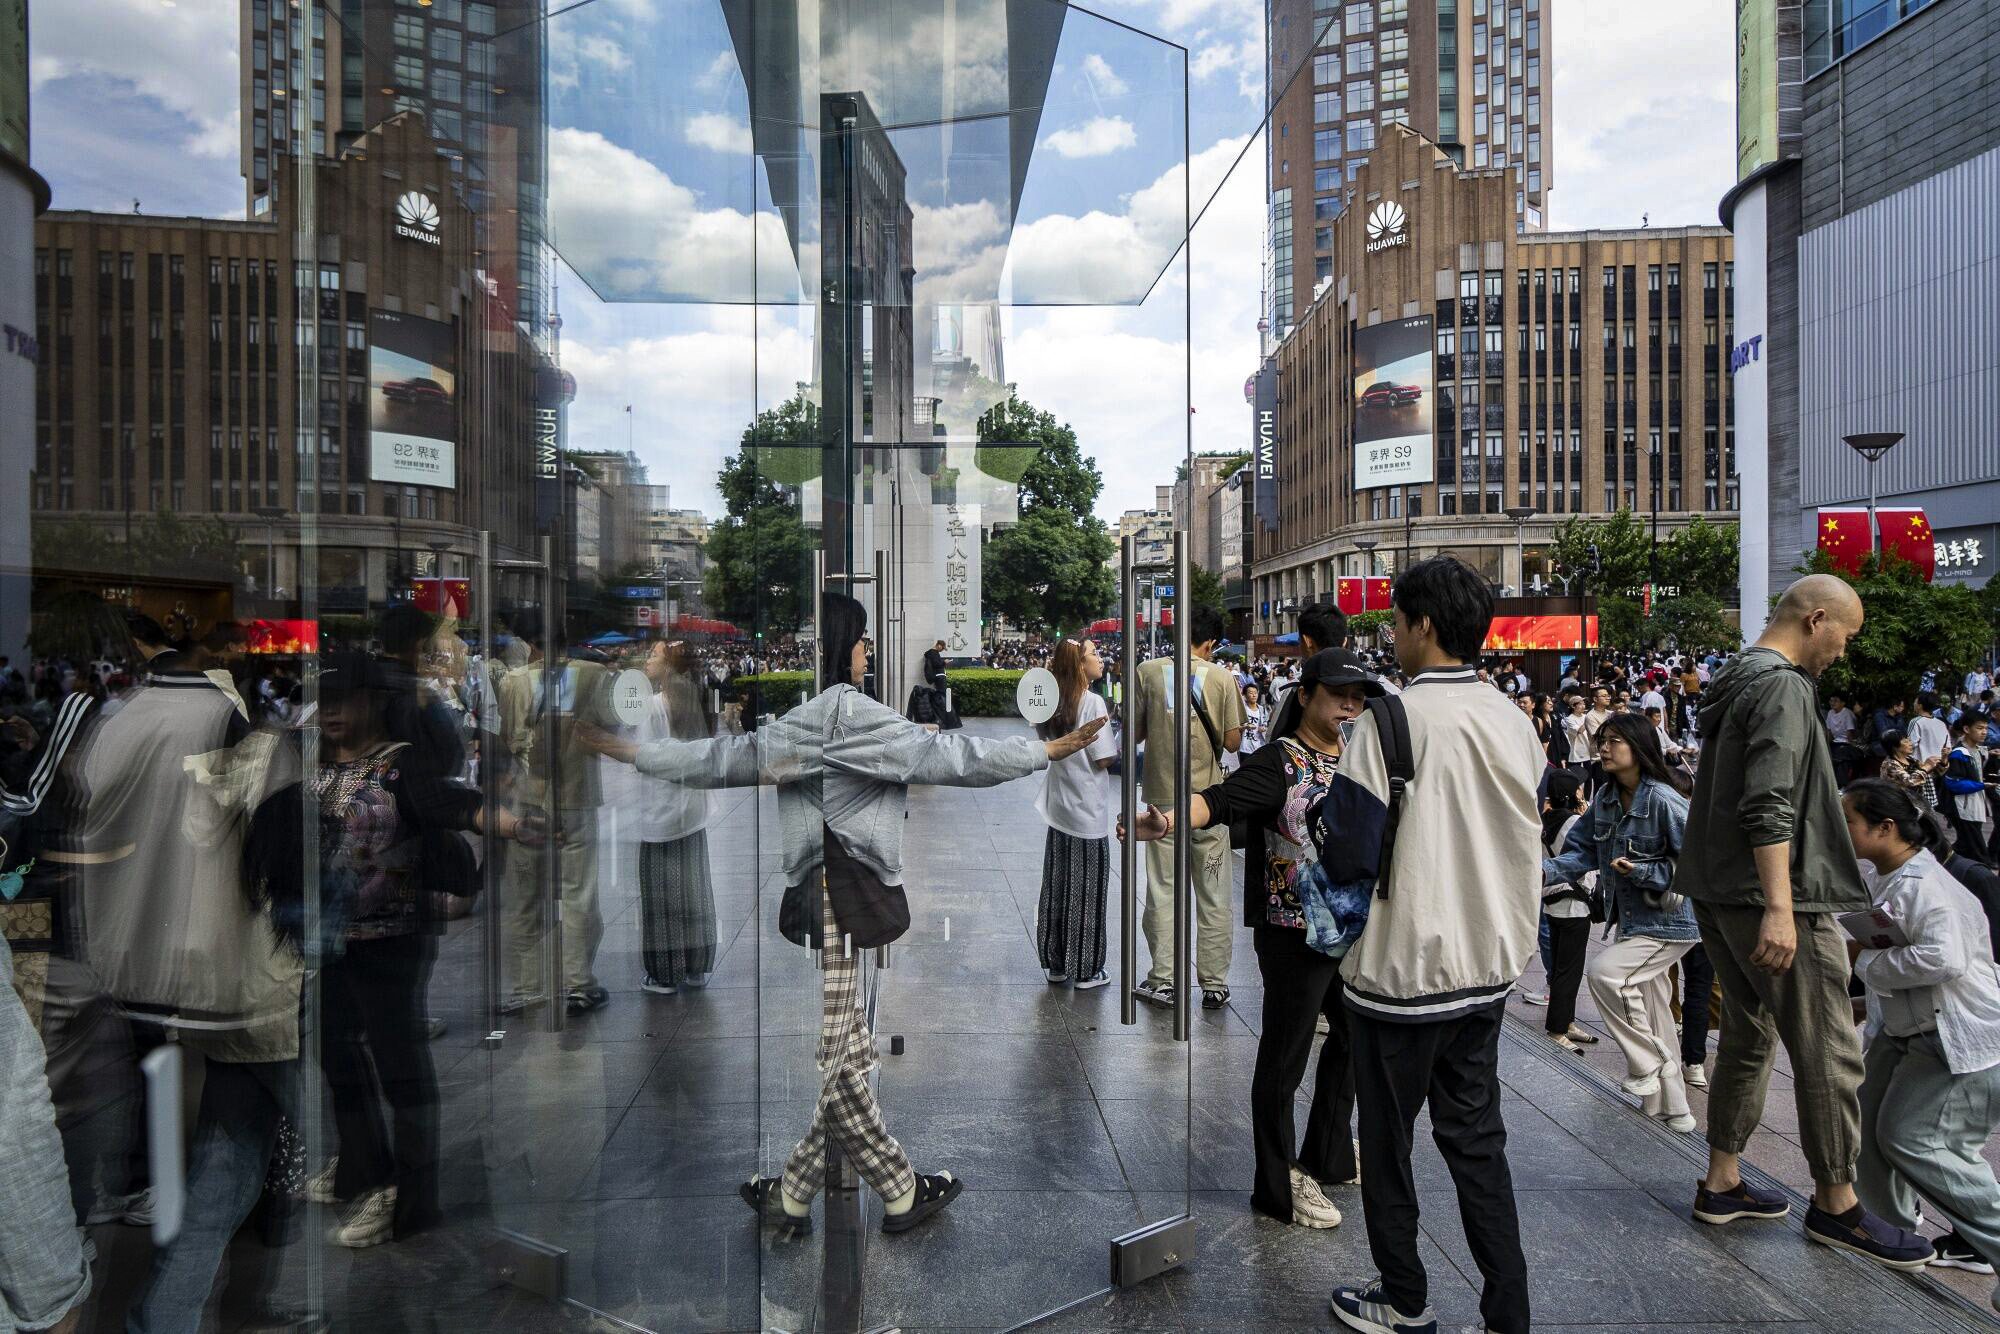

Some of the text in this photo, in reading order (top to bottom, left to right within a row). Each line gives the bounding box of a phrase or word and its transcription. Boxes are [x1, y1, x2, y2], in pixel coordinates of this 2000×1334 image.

[1366, 234, 1406, 253] HUAWEI
[1260, 410, 1273, 480] HUAWEI
[1370, 445, 1412, 462] 享界 S9
[1034, 684, 1043, 696] 拉
[1029, 698, 1047, 707] PULL
